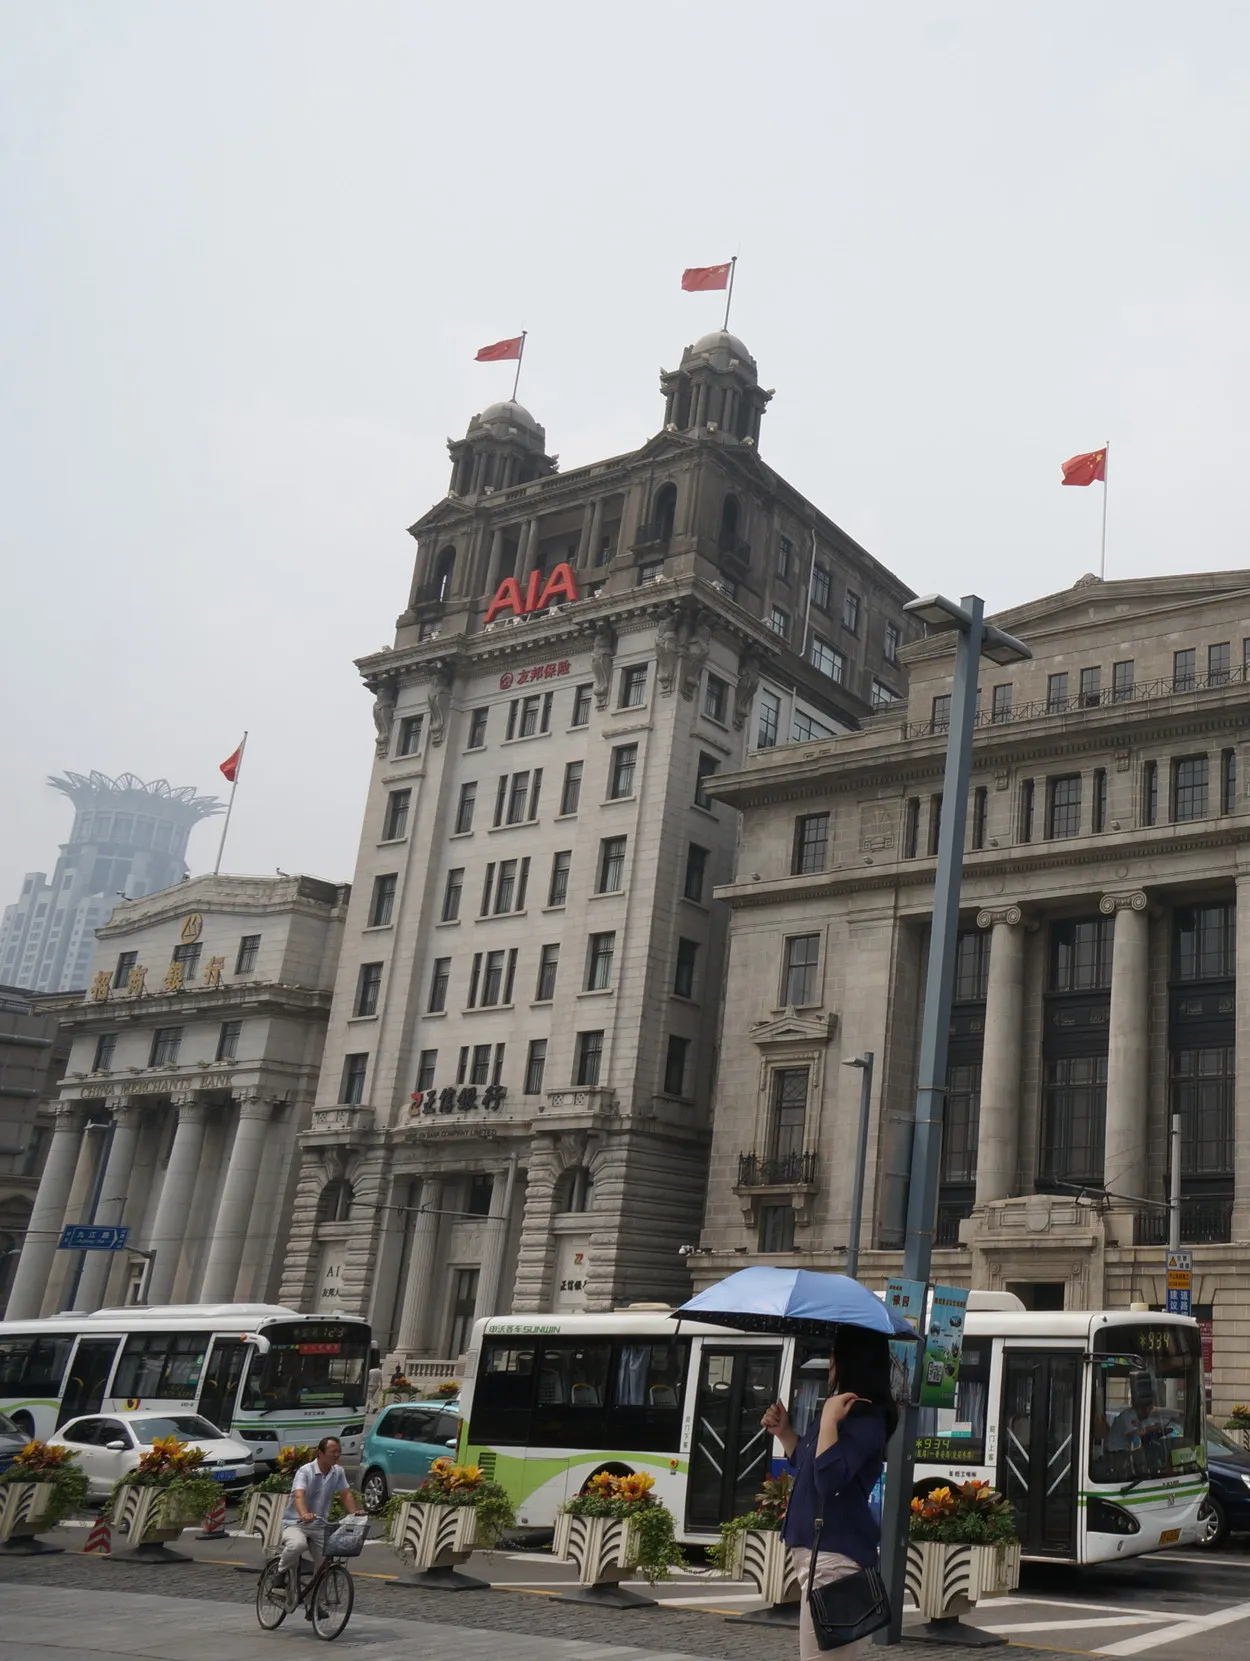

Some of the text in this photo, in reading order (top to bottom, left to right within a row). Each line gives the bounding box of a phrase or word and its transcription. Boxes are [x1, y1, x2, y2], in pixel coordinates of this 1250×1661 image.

[483, 562, 578, 624] AIA
[516, 659, 571, 686] 友邦保险
[91, 956, 226, 1001] 招商银行
[81, 1075, 233, 1098] CHINA MERCHANTS BANK
[422, 1085, 508, 1115] 正信银行
[523, 1325, 561, 1334] SUNWIN
